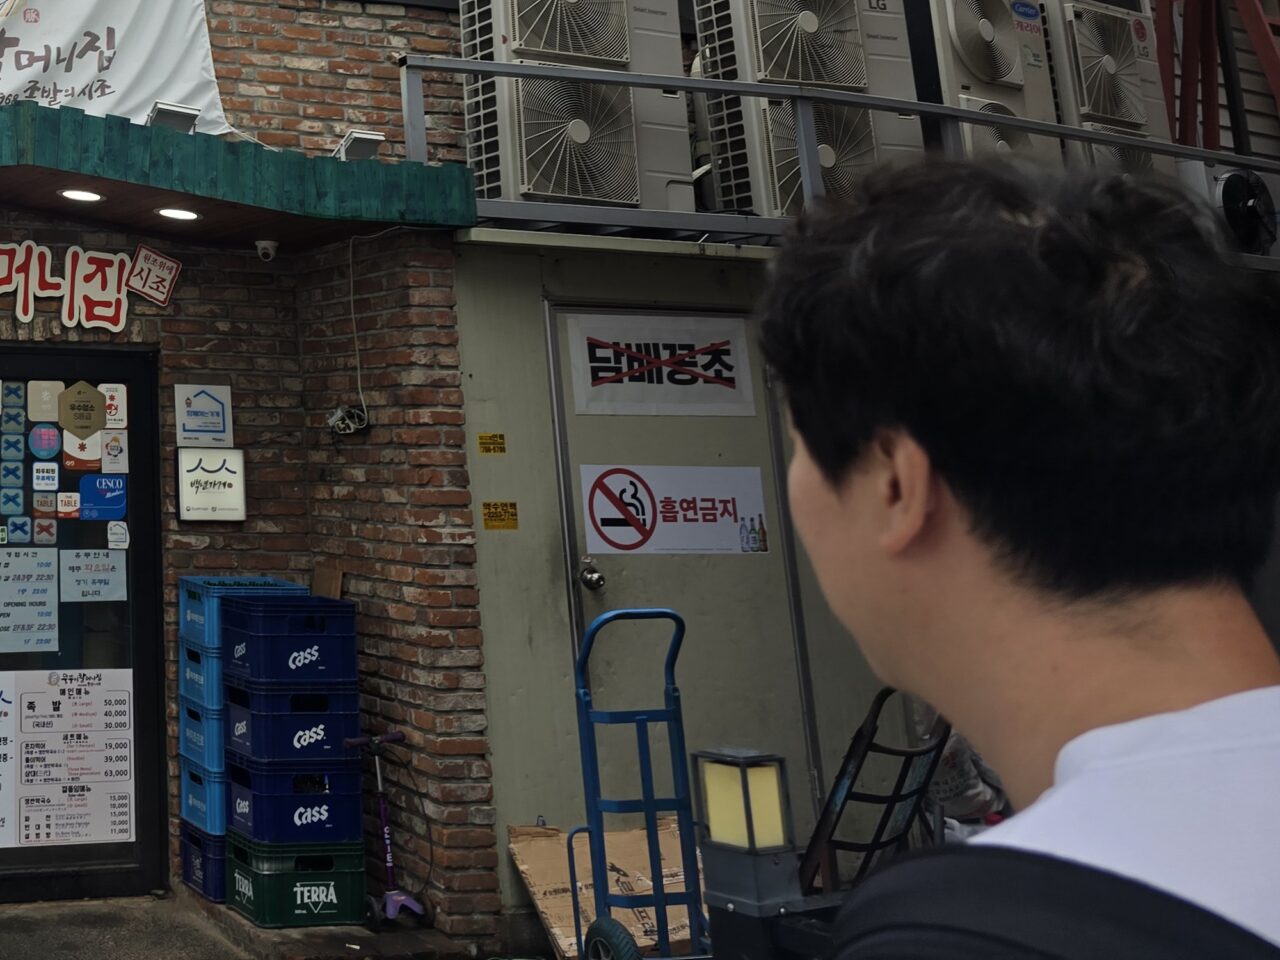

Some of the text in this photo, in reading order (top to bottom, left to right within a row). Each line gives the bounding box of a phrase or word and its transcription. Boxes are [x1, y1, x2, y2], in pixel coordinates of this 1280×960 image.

[1136, 45, 1150, 58] LG
[133, 266, 167, 296] 시조
[587, 341, 736, 387] 담배꽁초
[96, 478, 123, 489] CESCO
[36, 499, 54, 508] TABLE
[60, 499, 78, 508] TABLE
[660, 497, 739, 523] 흡연금지
[288, 645, 320, 670] Cass
[104, 699, 127, 707] 50,000
[235, 720, 247, 736] Cass
[293, 724, 325, 749] Cass
[104, 742, 128, 750] 19,000
[104, 755, 128, 763] 39,000
[104, 769, 128, 777] 63,000
[236, 798, 249, 814] Cass
[293, 804, 328, 826] Cass
[293, 885, 338, 905] TERRA
